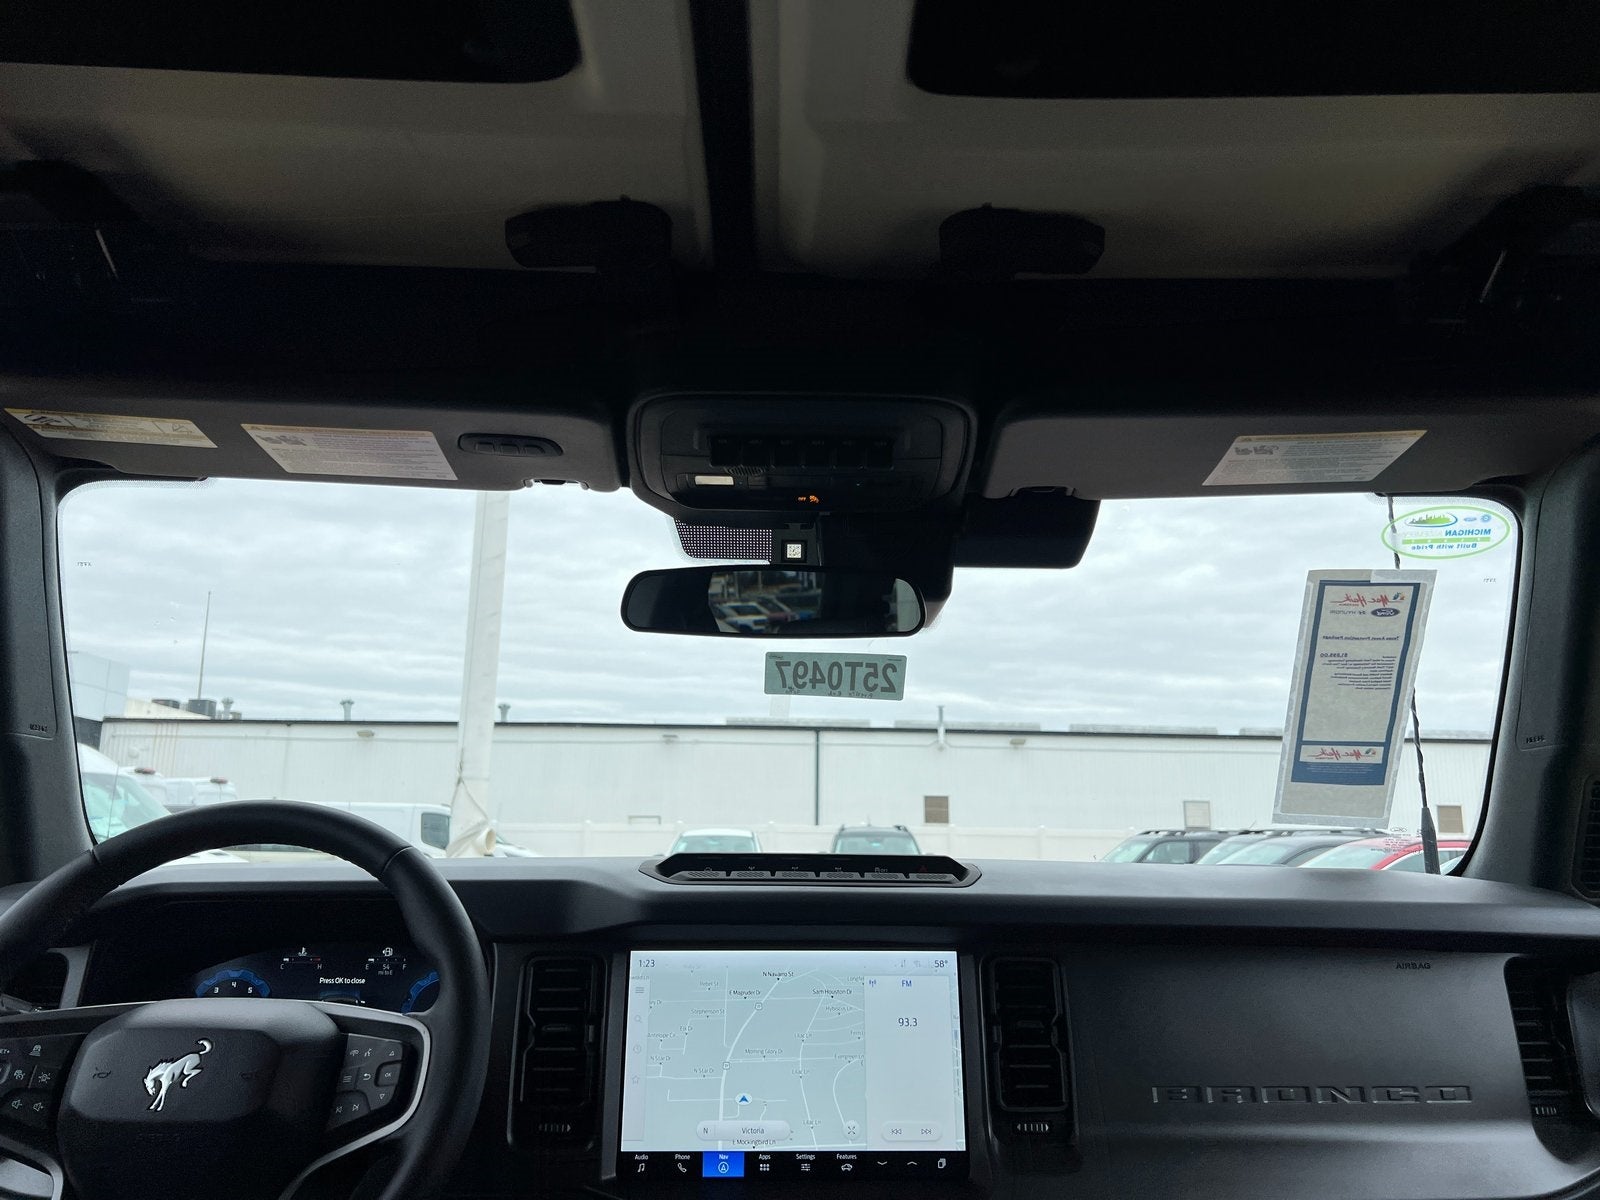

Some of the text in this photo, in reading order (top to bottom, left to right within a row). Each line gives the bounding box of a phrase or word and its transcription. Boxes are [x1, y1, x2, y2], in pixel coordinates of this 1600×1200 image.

[639, 959, 656, 968] 1:23
[1396, 961, 1431, 970] AIRBAG
[319, 976, 335, 984] Press
[334, 976, 344, 984] OK
[902, 979, 912, 988] FM
[213, 986, 219, 994] 3
[247, 986, 253, 994] 5
[898, 1017, 918, 1027] 93.3
[1151, 1085, 1472, 1105] BRONCO
[741, 1126, 765, 1135] Victoria
[736, 1138, 769, 1146] Mockingbird
[758, 1153, 771, 1161] Apps
[795, 1153, 816, 1161] Settings
